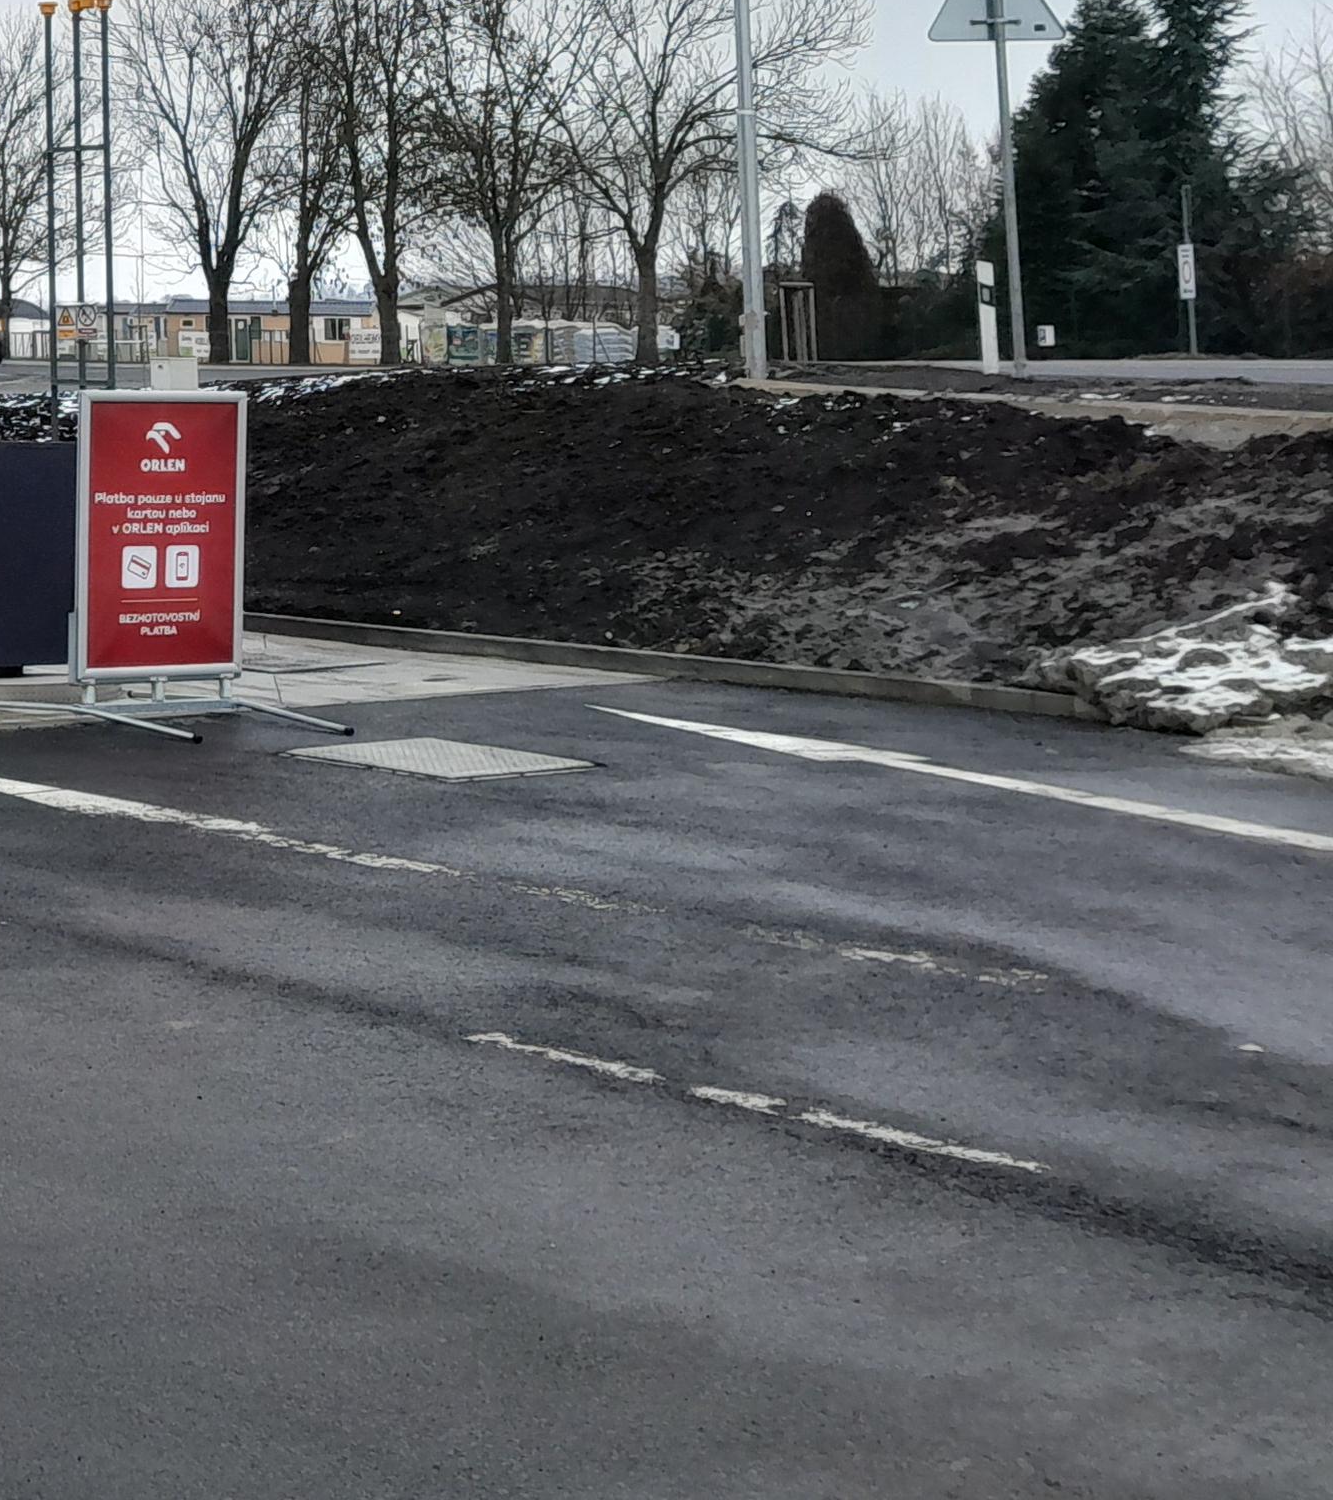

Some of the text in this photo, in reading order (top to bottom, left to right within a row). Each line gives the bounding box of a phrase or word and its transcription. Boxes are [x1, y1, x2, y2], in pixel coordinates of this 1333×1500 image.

[140, 458, 186, 472] ORLEN
[94, 491, 226, 506] Platba pauze u stojanu
[126, 506, 197, 519] kartou nebo
[112, 521, 210, 536] v ORLEN aplikaci
[118, 608, 201, 624] BEZHOTOVOSTNÍ
[140, 625, 178, 636] PLATBA
